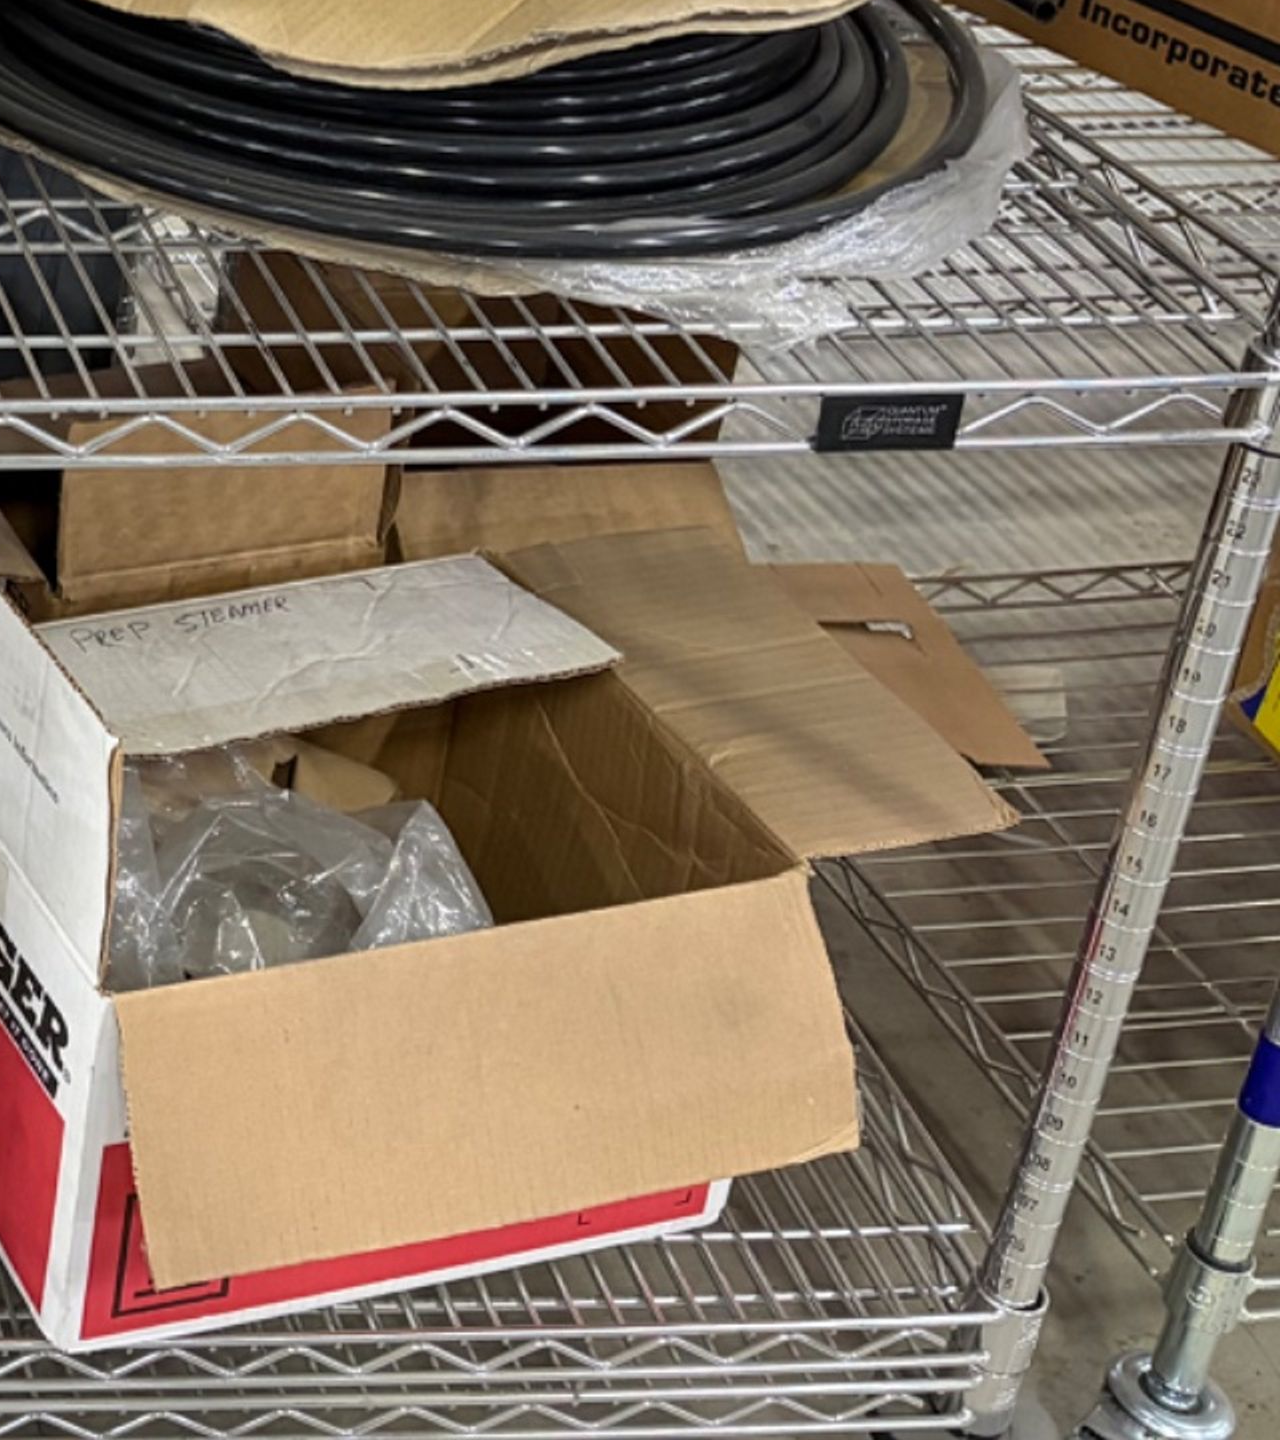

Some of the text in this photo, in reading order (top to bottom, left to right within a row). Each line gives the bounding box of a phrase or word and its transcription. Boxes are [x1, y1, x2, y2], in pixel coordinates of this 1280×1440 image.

[69, 594, 292, 653] PREP STEAMER
[1167, 714, 1187, 735] 18
[1153, 762, 1172, 782] 17
[1140, 809, 1158, 828] 16
[1112, 898, 1130, 918] 14
[1099, 942, 1117, 962] 13
[1086, 986, 1103, 1005] 12
[1073, 1030, 1089, 1047] 11
